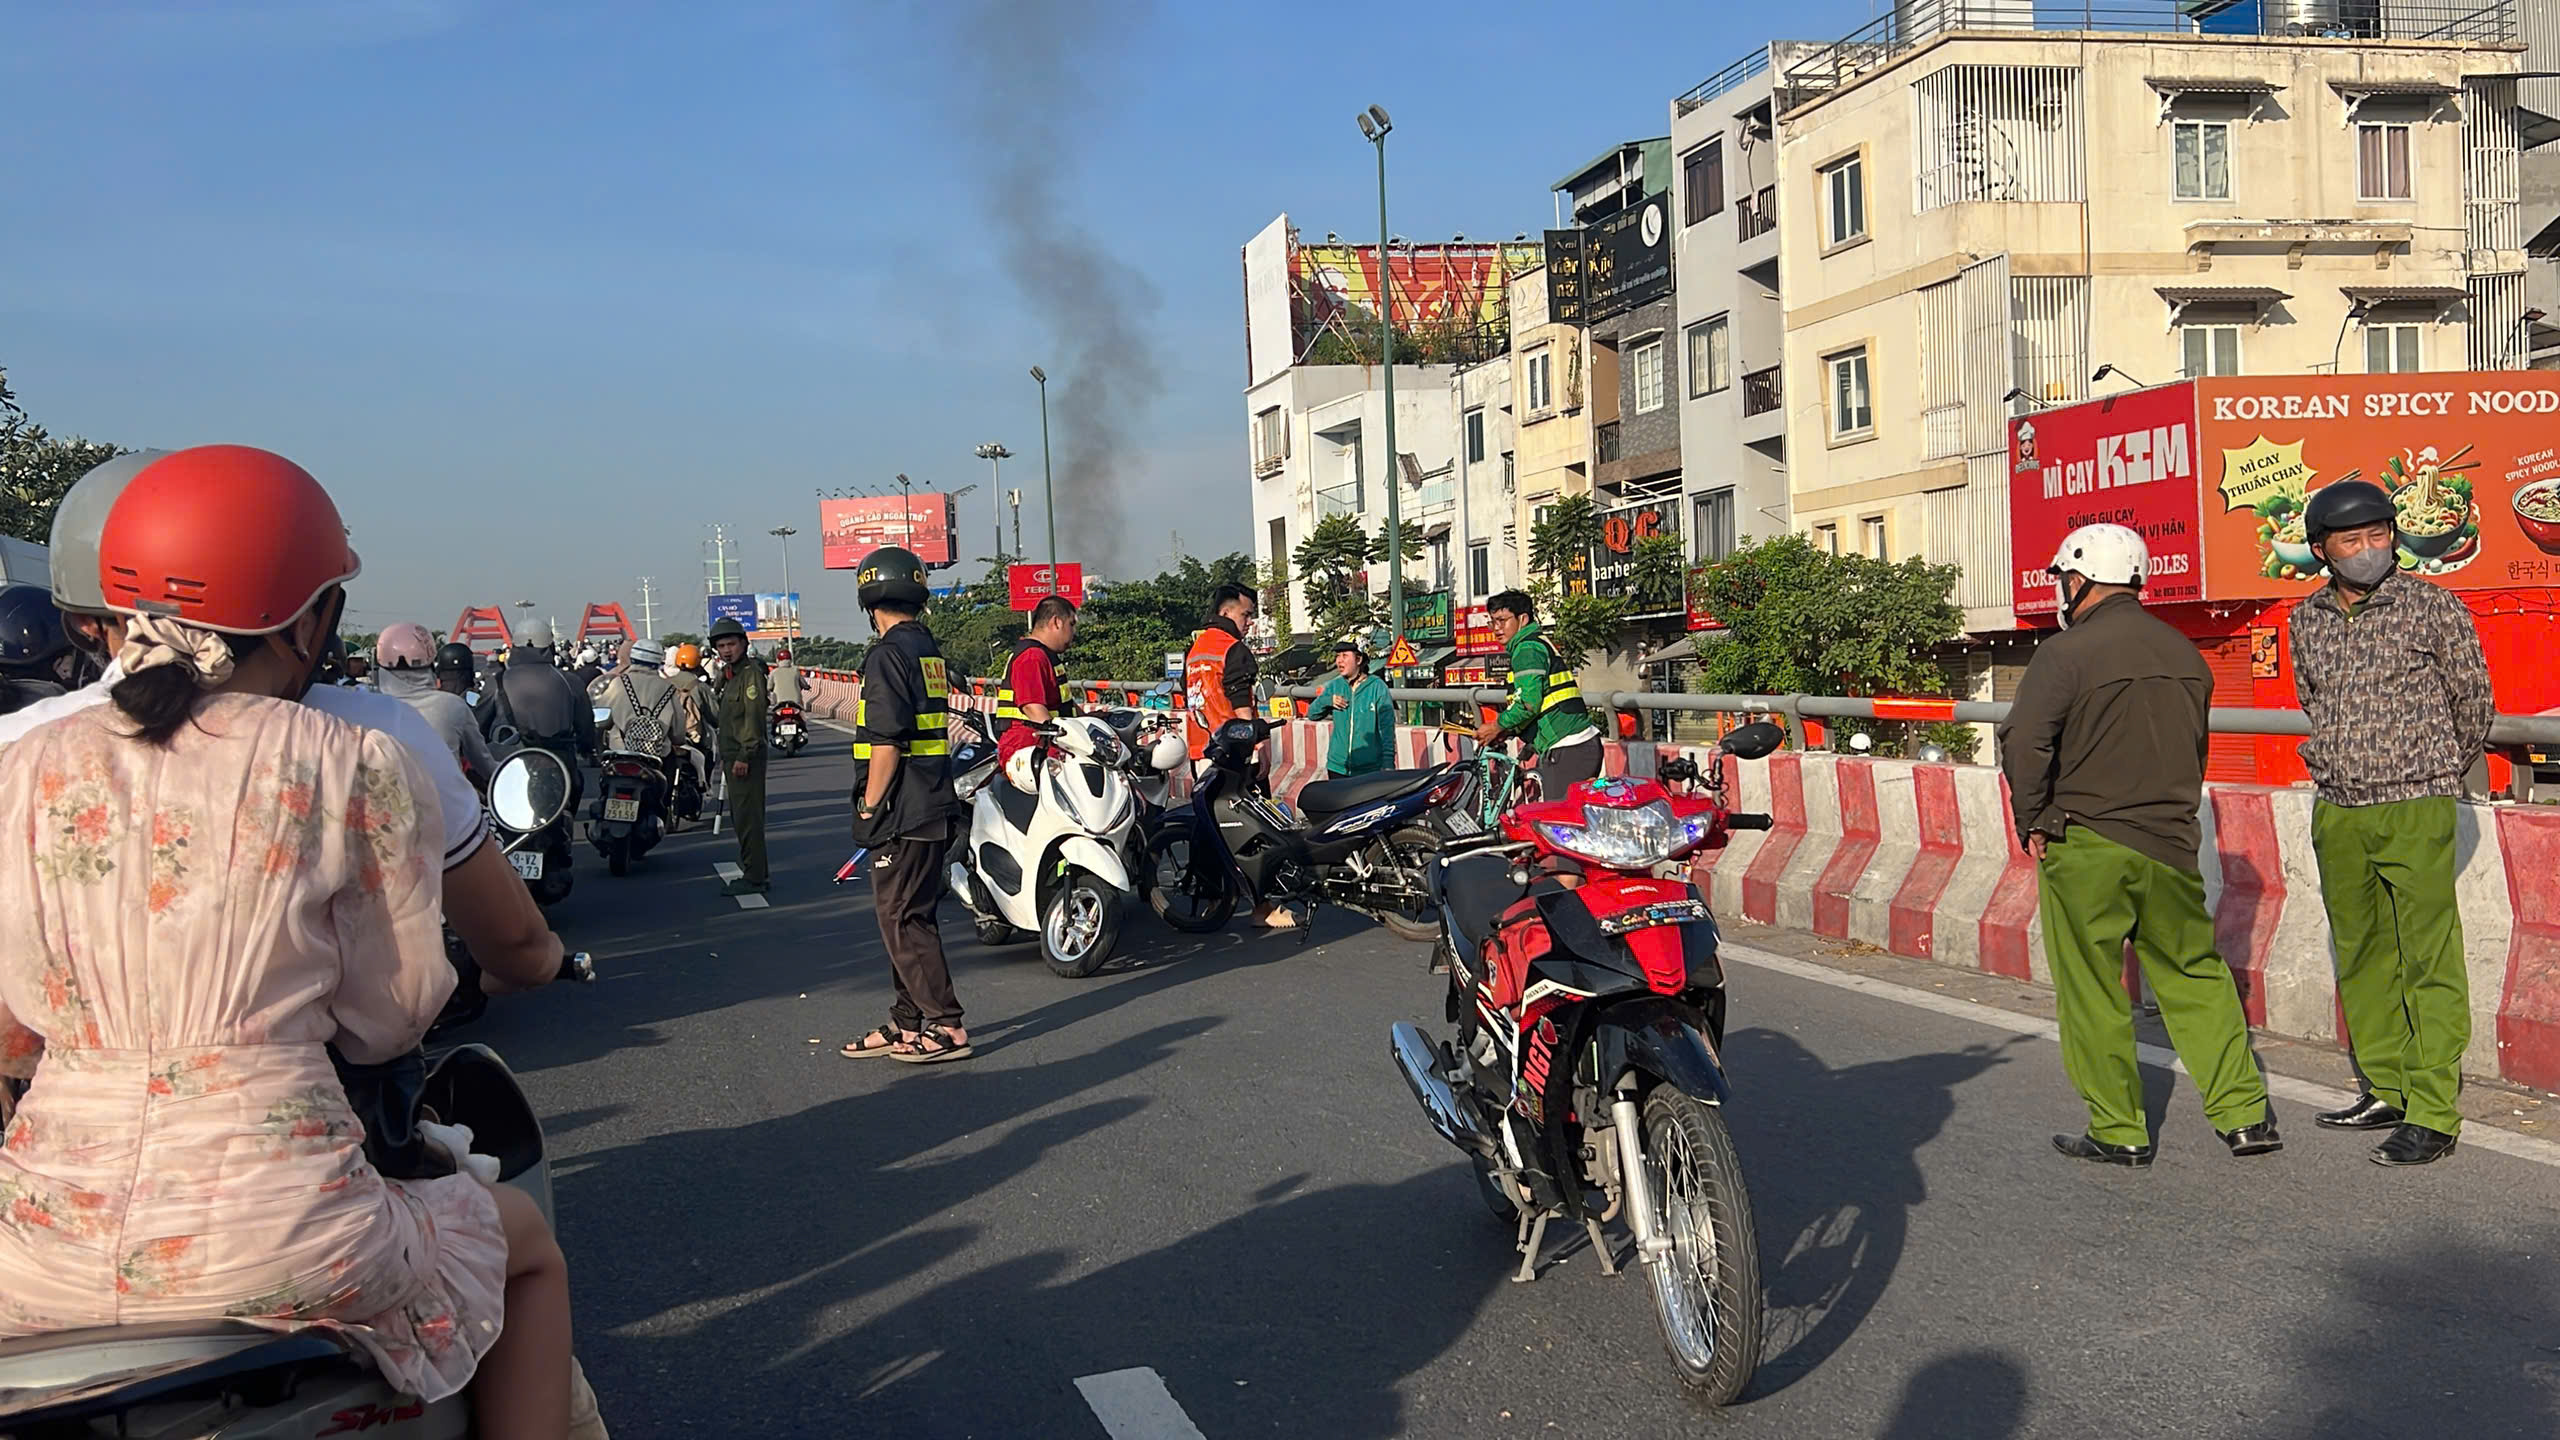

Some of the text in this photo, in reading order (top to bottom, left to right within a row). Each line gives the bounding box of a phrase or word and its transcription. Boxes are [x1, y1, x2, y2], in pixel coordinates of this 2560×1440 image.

[2214, 390, 2560, 420] KOREAN SPICY NOOD
[2043, 423, 2191, 500] MÌ CAY KIM
[2239, 453, 2281, 476] MÌ CAY
[2517, 448, 2554, 467] KOREAN
[2271, 464, 2304, 487] CHAY
[2505, 467, 2529, 482] SPICY
[2067, 508, 2135, 529] ĐÚNG GU CAY
[2022, 554, 2189, 589] KORE DLES
[2508, 559, 2549, 580] 한국식
[513, 853, 537, 866] 9-V2
[1620, 884, 1658, 894] HONDA
[1523, 1029, 1552, 1096] NGT
